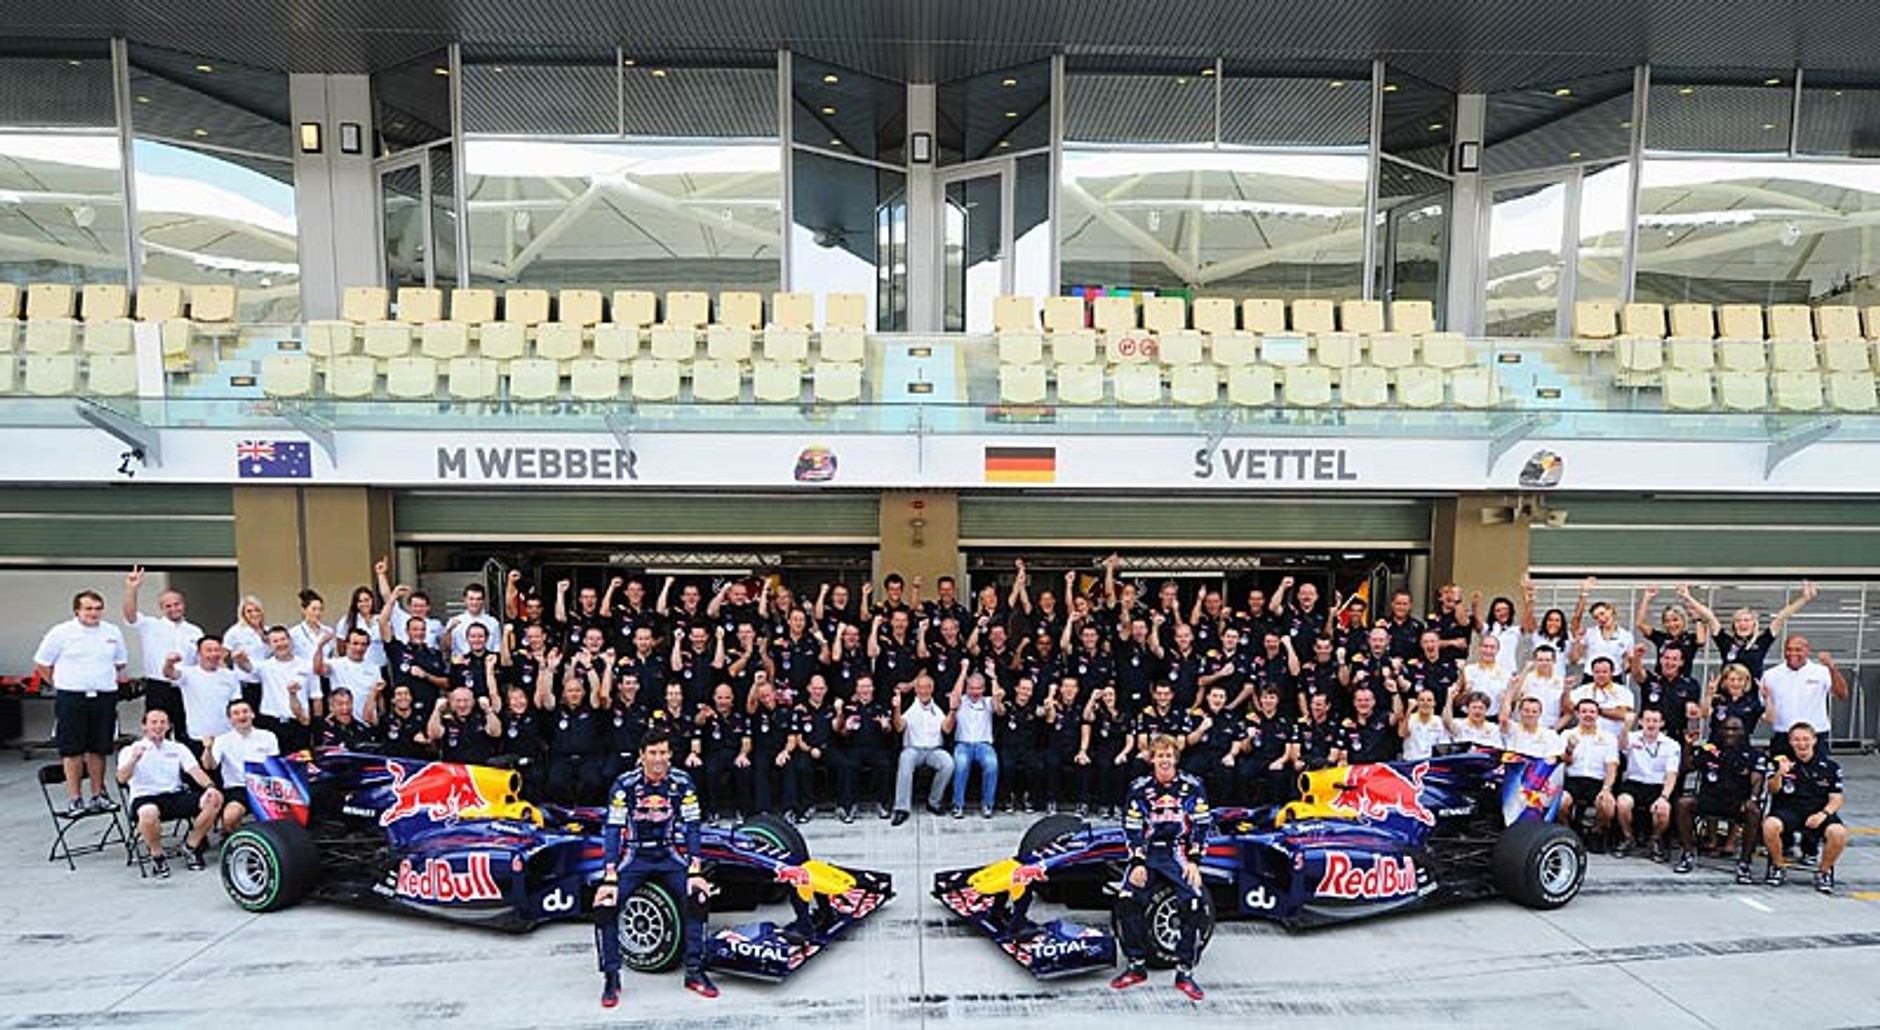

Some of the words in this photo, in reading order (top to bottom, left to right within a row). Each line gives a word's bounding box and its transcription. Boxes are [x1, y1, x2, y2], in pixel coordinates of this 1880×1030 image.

[437, 447, 467, 479] M
[476, 447, 639, 480] WEBBER
[1194, 448, 1214, 479] S
[1221, 449, 1358, 481] VETTEL
[512, 854, 523, 872] 6
[1294, 851, 1304, 870] 5
[397, 858, 434, 897] Red
[435, 852, 502, 902] Bull
[1314, 852, 1380, 899] Red
[1378, 855, 1418, 898] Bull
[542, 888, 575, 912] du
[1246, 885, 1276, 909] du
[730, 941, 789, 962] TOTAL
[1032, 940, 1090, 959] TOTAL
